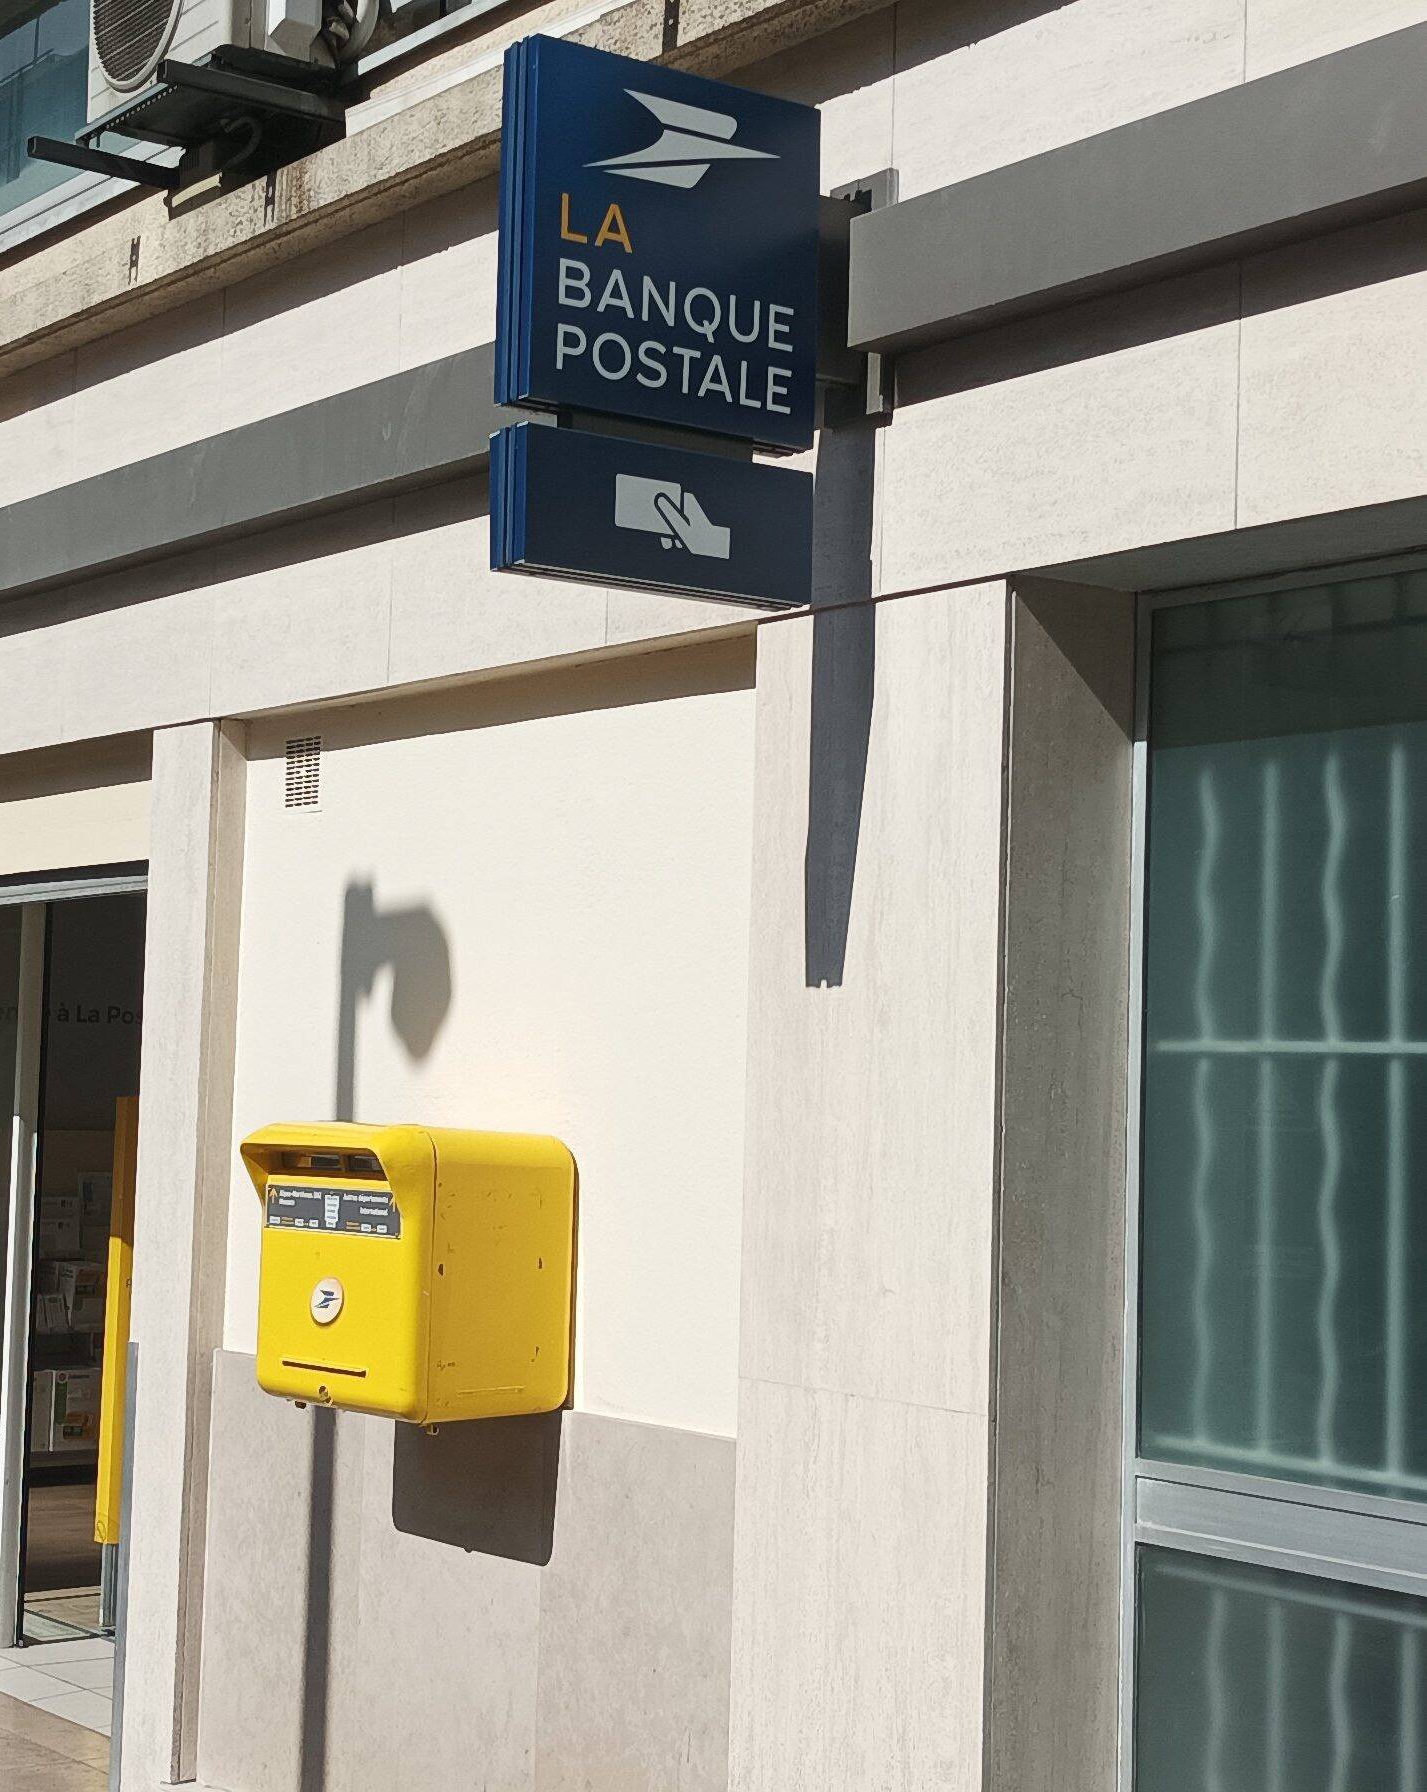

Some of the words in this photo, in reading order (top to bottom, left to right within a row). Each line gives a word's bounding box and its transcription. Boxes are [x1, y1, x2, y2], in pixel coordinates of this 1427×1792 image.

[560, 192, 633, 254] LA
[558, 257, 795, 353] BANQUE
[555, 322, 793, 415] POSTALE
[76, 1004, 101, 1024] La
